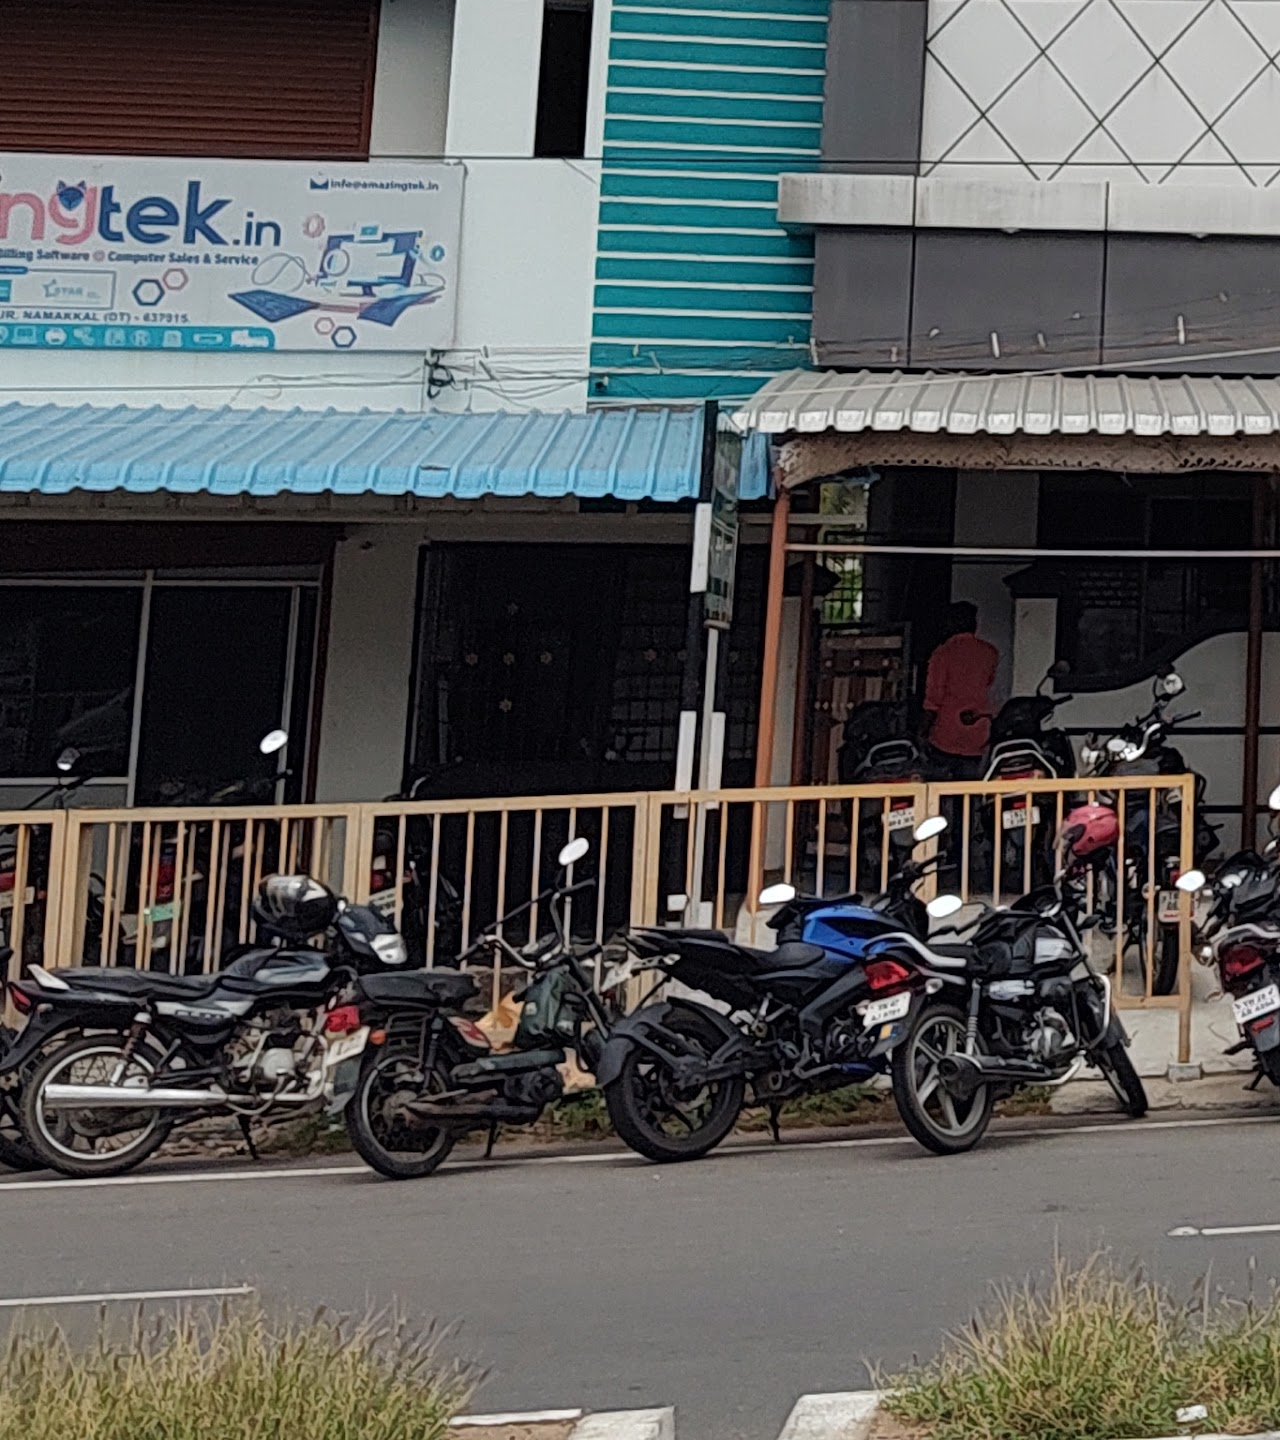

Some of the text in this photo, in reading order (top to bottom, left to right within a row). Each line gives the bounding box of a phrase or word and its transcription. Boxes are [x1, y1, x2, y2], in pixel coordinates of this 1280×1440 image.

[36, 248, 91, 261] Software
[107, 250, 166, 265] Computer
[168, 252, 200, 264] Sales
[214, 252, 260, 266] Service
[23, 310, 100, 322] NAMAKKAL
